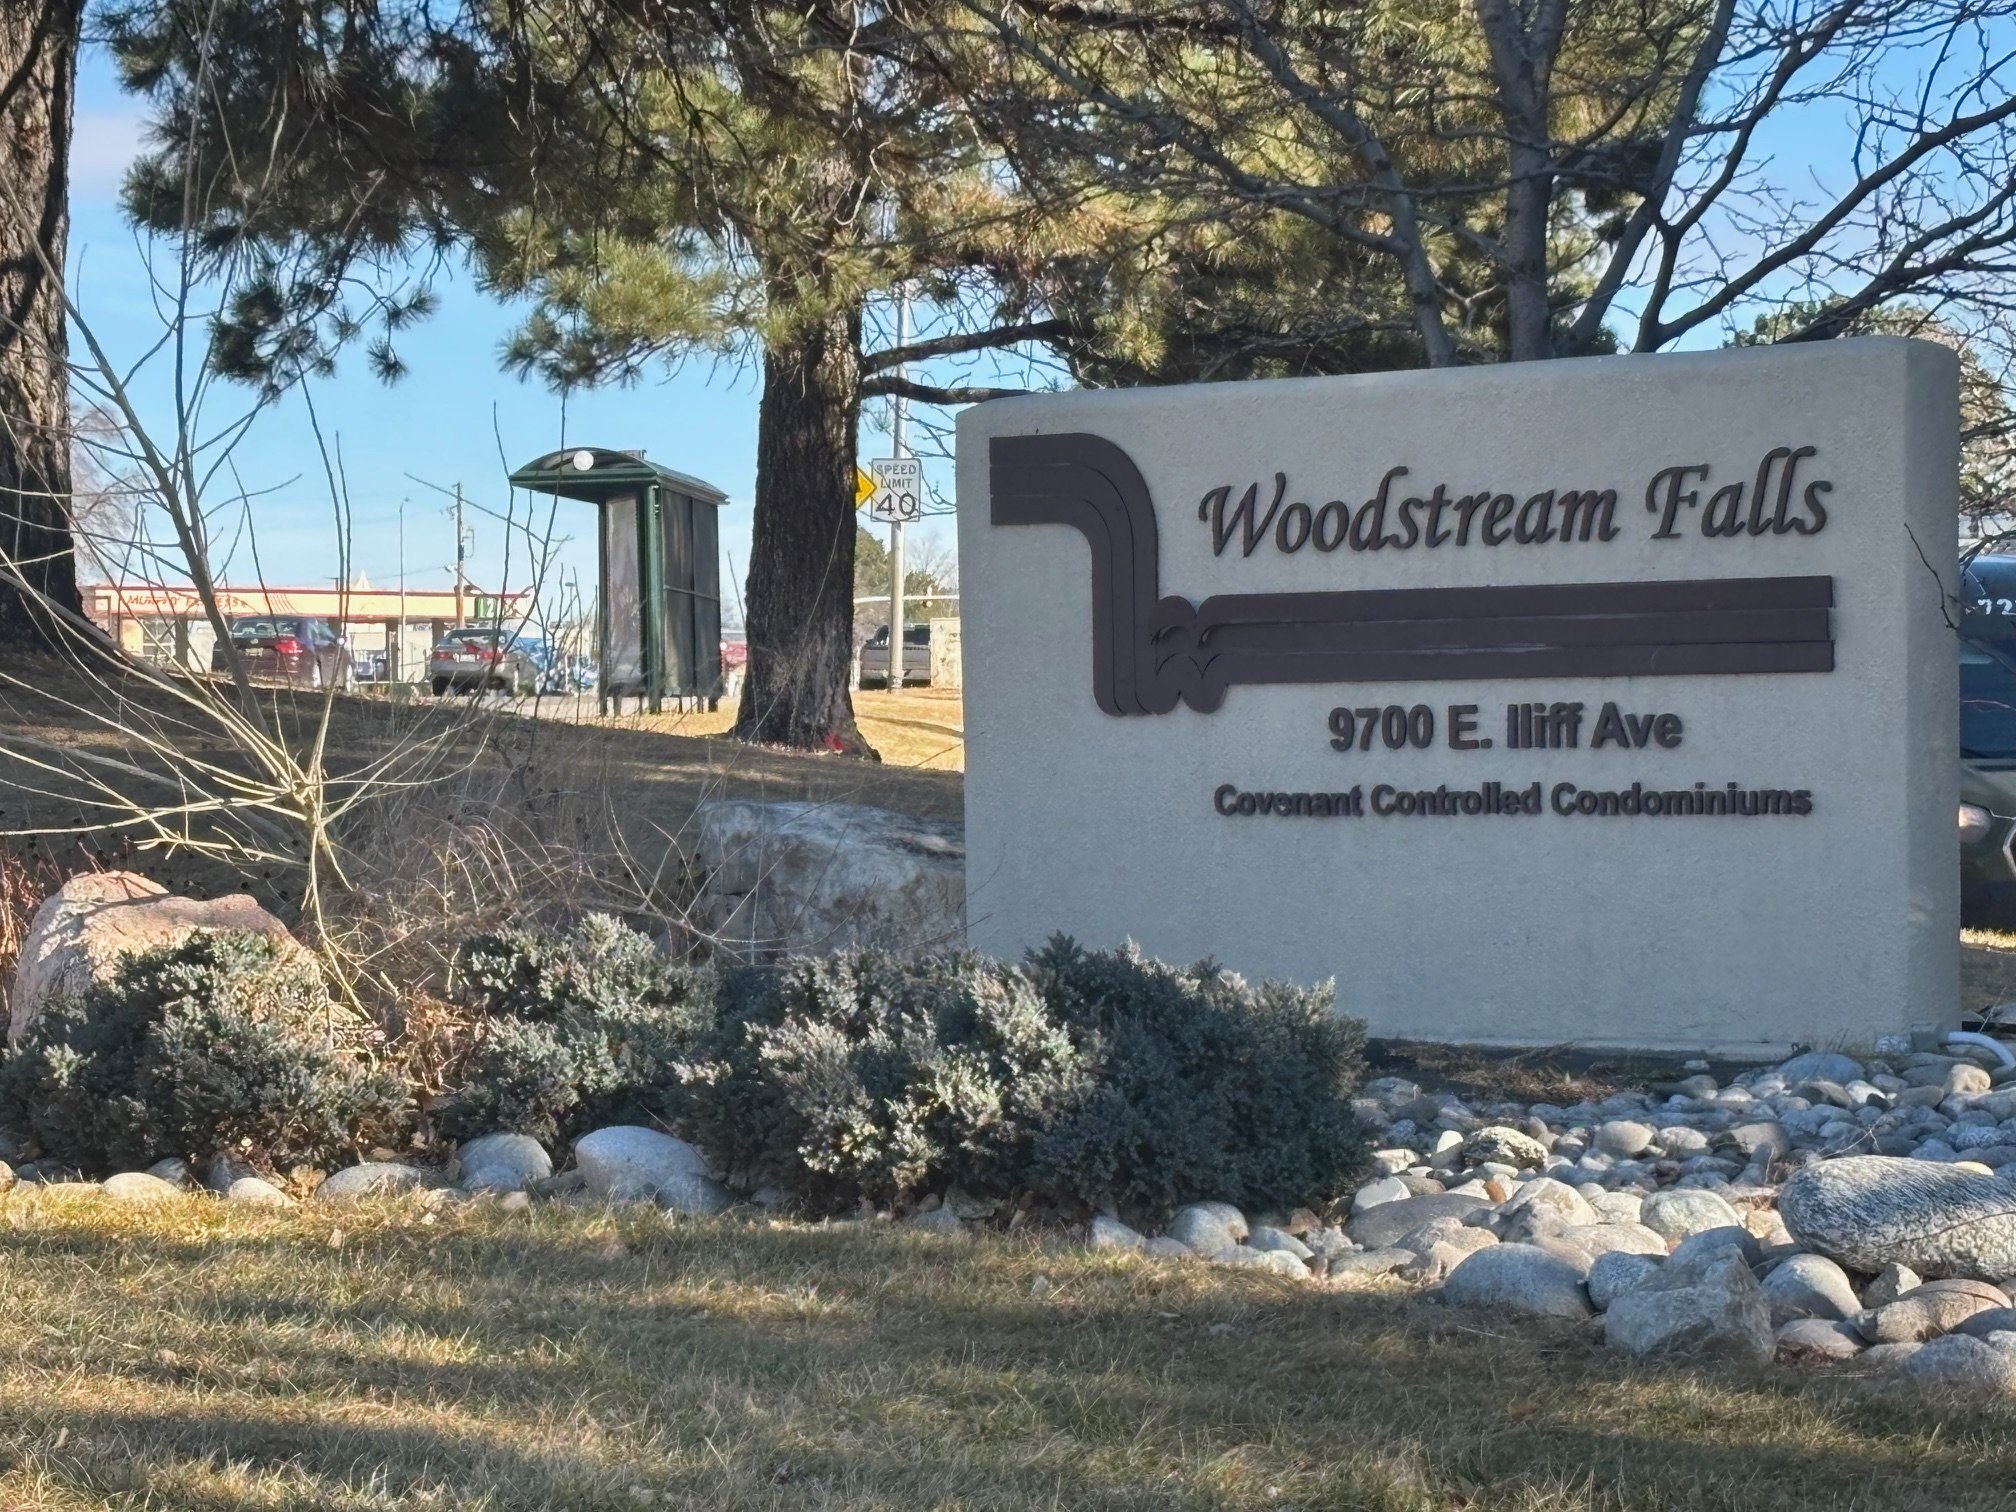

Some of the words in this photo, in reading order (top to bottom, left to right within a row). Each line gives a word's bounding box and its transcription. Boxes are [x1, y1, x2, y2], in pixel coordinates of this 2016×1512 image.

[876, 464, 917, 475] SPEED
[880, 478, 913, 489] LIMIT
[875, 493, 916, 517] 40
[1198, 465, 1621, 558] Woodstream
[1645, 445, 1834, 539] Falls
[1977, 598, 2016, 616] 72
[1328, 704, 1434, 751] 9700
[1448, 704, 1493, 750] E.
[1506, 702, 1584, 749] Iliff
[1590, 701, 1684, 749] Ave
[1213, 783, 1364, 817] Covenant
[1370, 781, 1543, 817] Controlled
[1551, 781, 1813, 816] Condominiums
